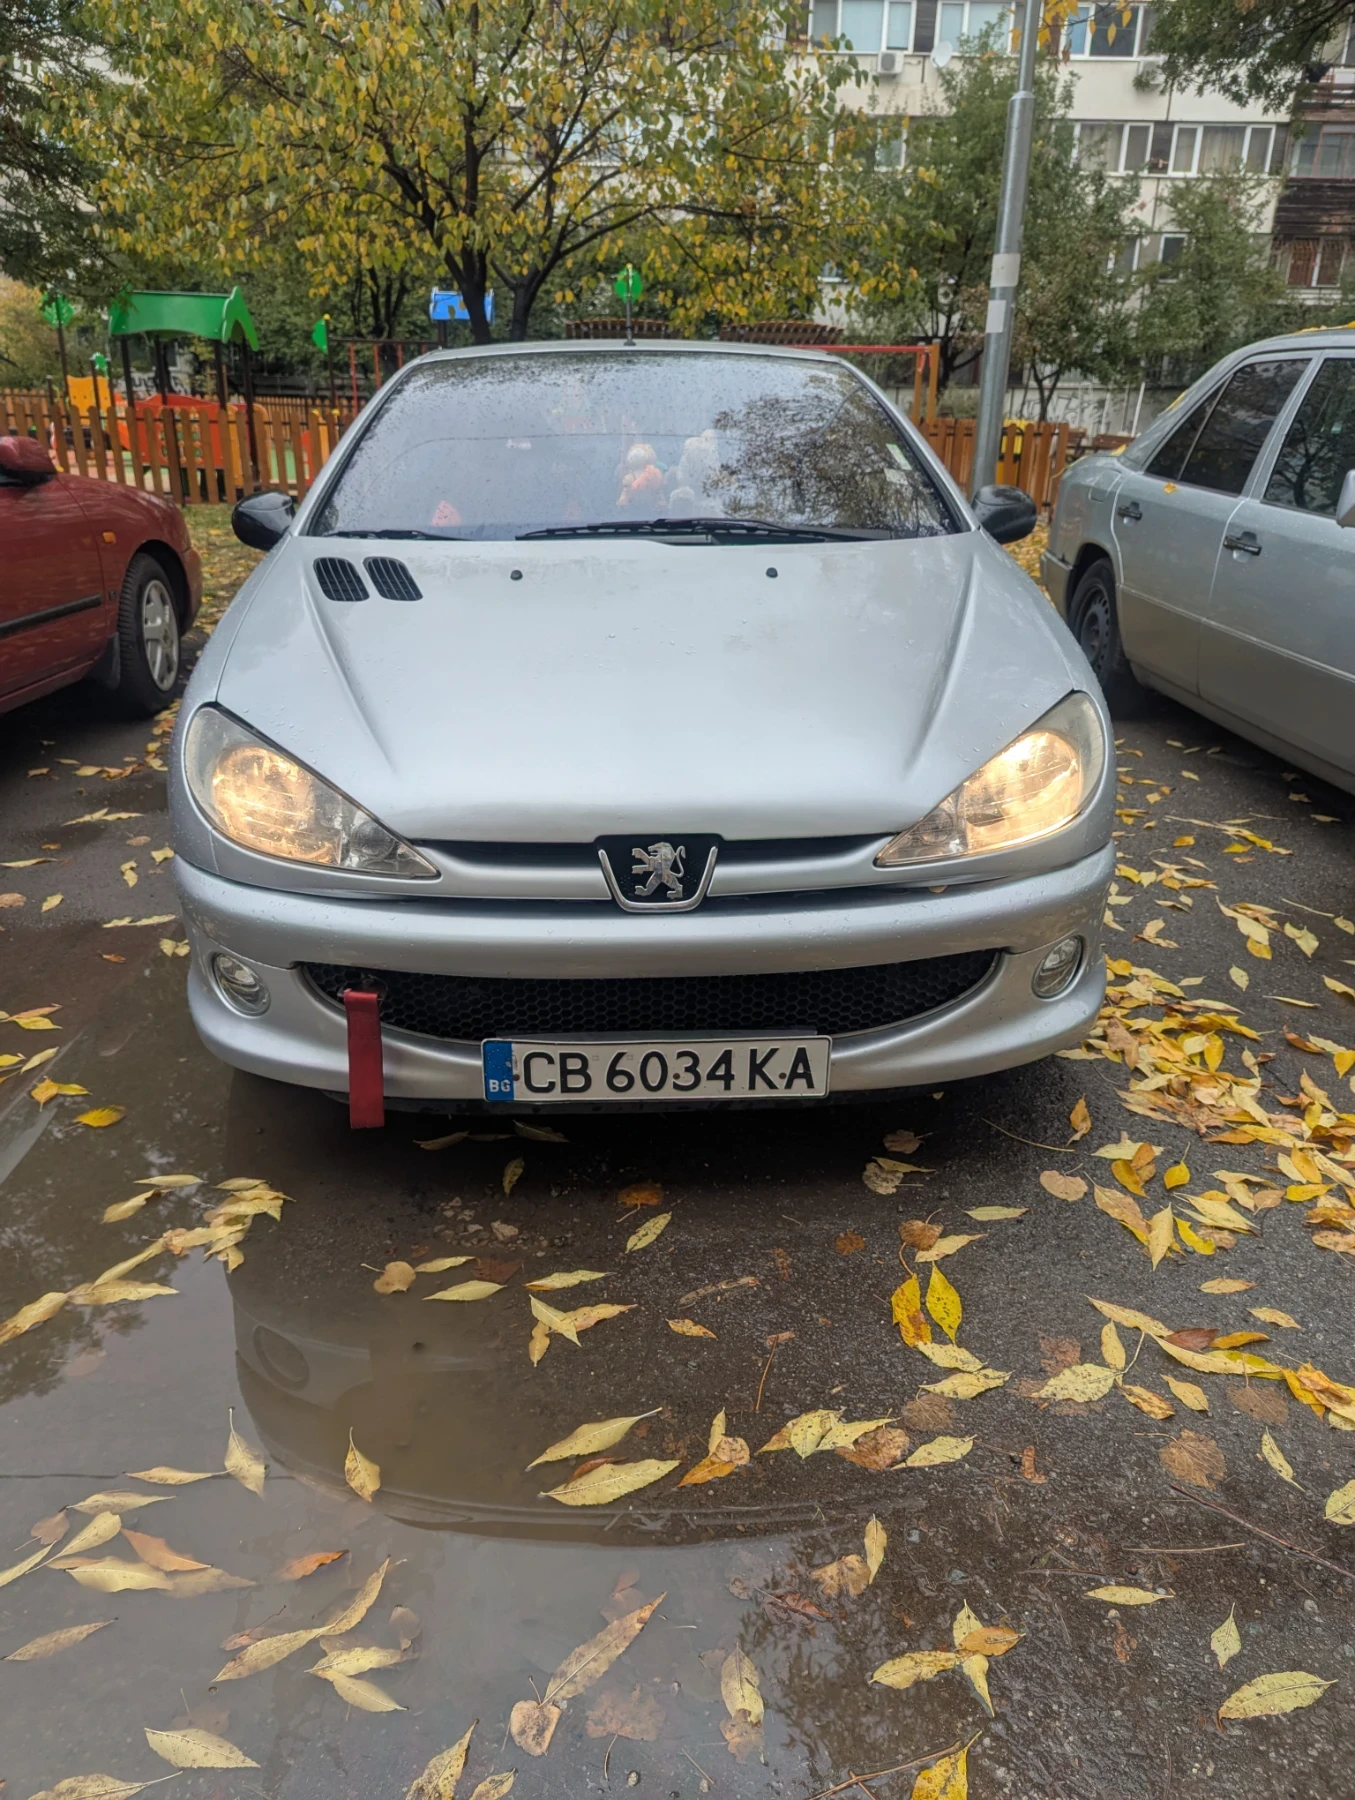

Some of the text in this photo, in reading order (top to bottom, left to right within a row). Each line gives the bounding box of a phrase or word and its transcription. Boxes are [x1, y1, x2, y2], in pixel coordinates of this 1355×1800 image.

[523, 1047, 815, 1093] CB 6034 KA
[489, 1079, 511, 1092] BG
